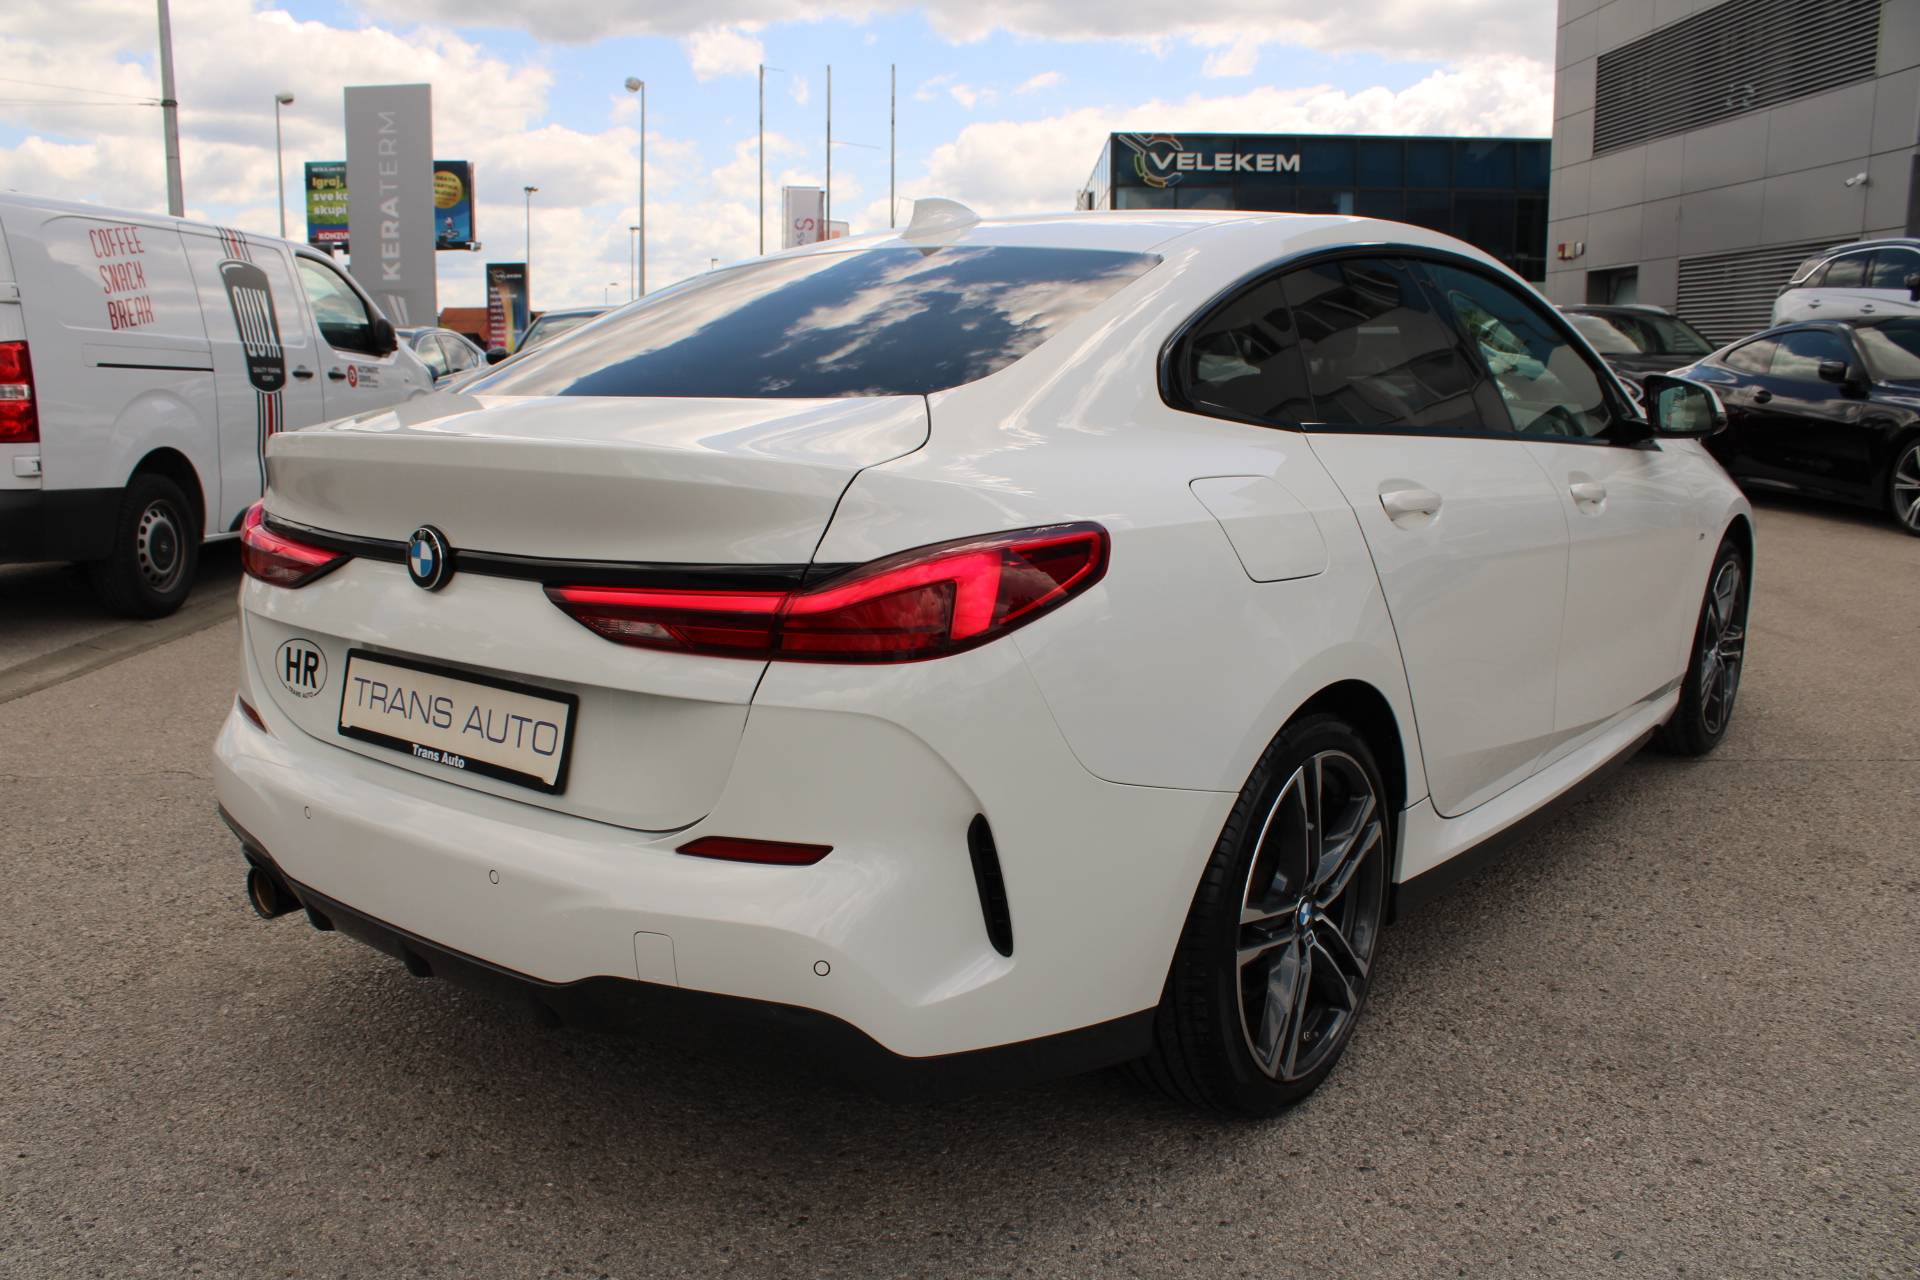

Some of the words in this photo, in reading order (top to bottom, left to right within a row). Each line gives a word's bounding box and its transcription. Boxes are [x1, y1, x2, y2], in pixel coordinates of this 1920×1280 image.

[1150, 152, 1300, 173] VELEKEM
[377, 111, 401, 281] KERATERM
[89, 226, 145, 258] COFFEE
[99, 260, 146, 294] SNACK
[107, 295, 154, 330] BREAK
[286, 647, 317, 688] HR
[354, 677, 453, 729] TRANS
[462, 705, 559, 756] AUTO
[412, 744, 439, 762] Trans
[441, 754, 465, 769] Auto
